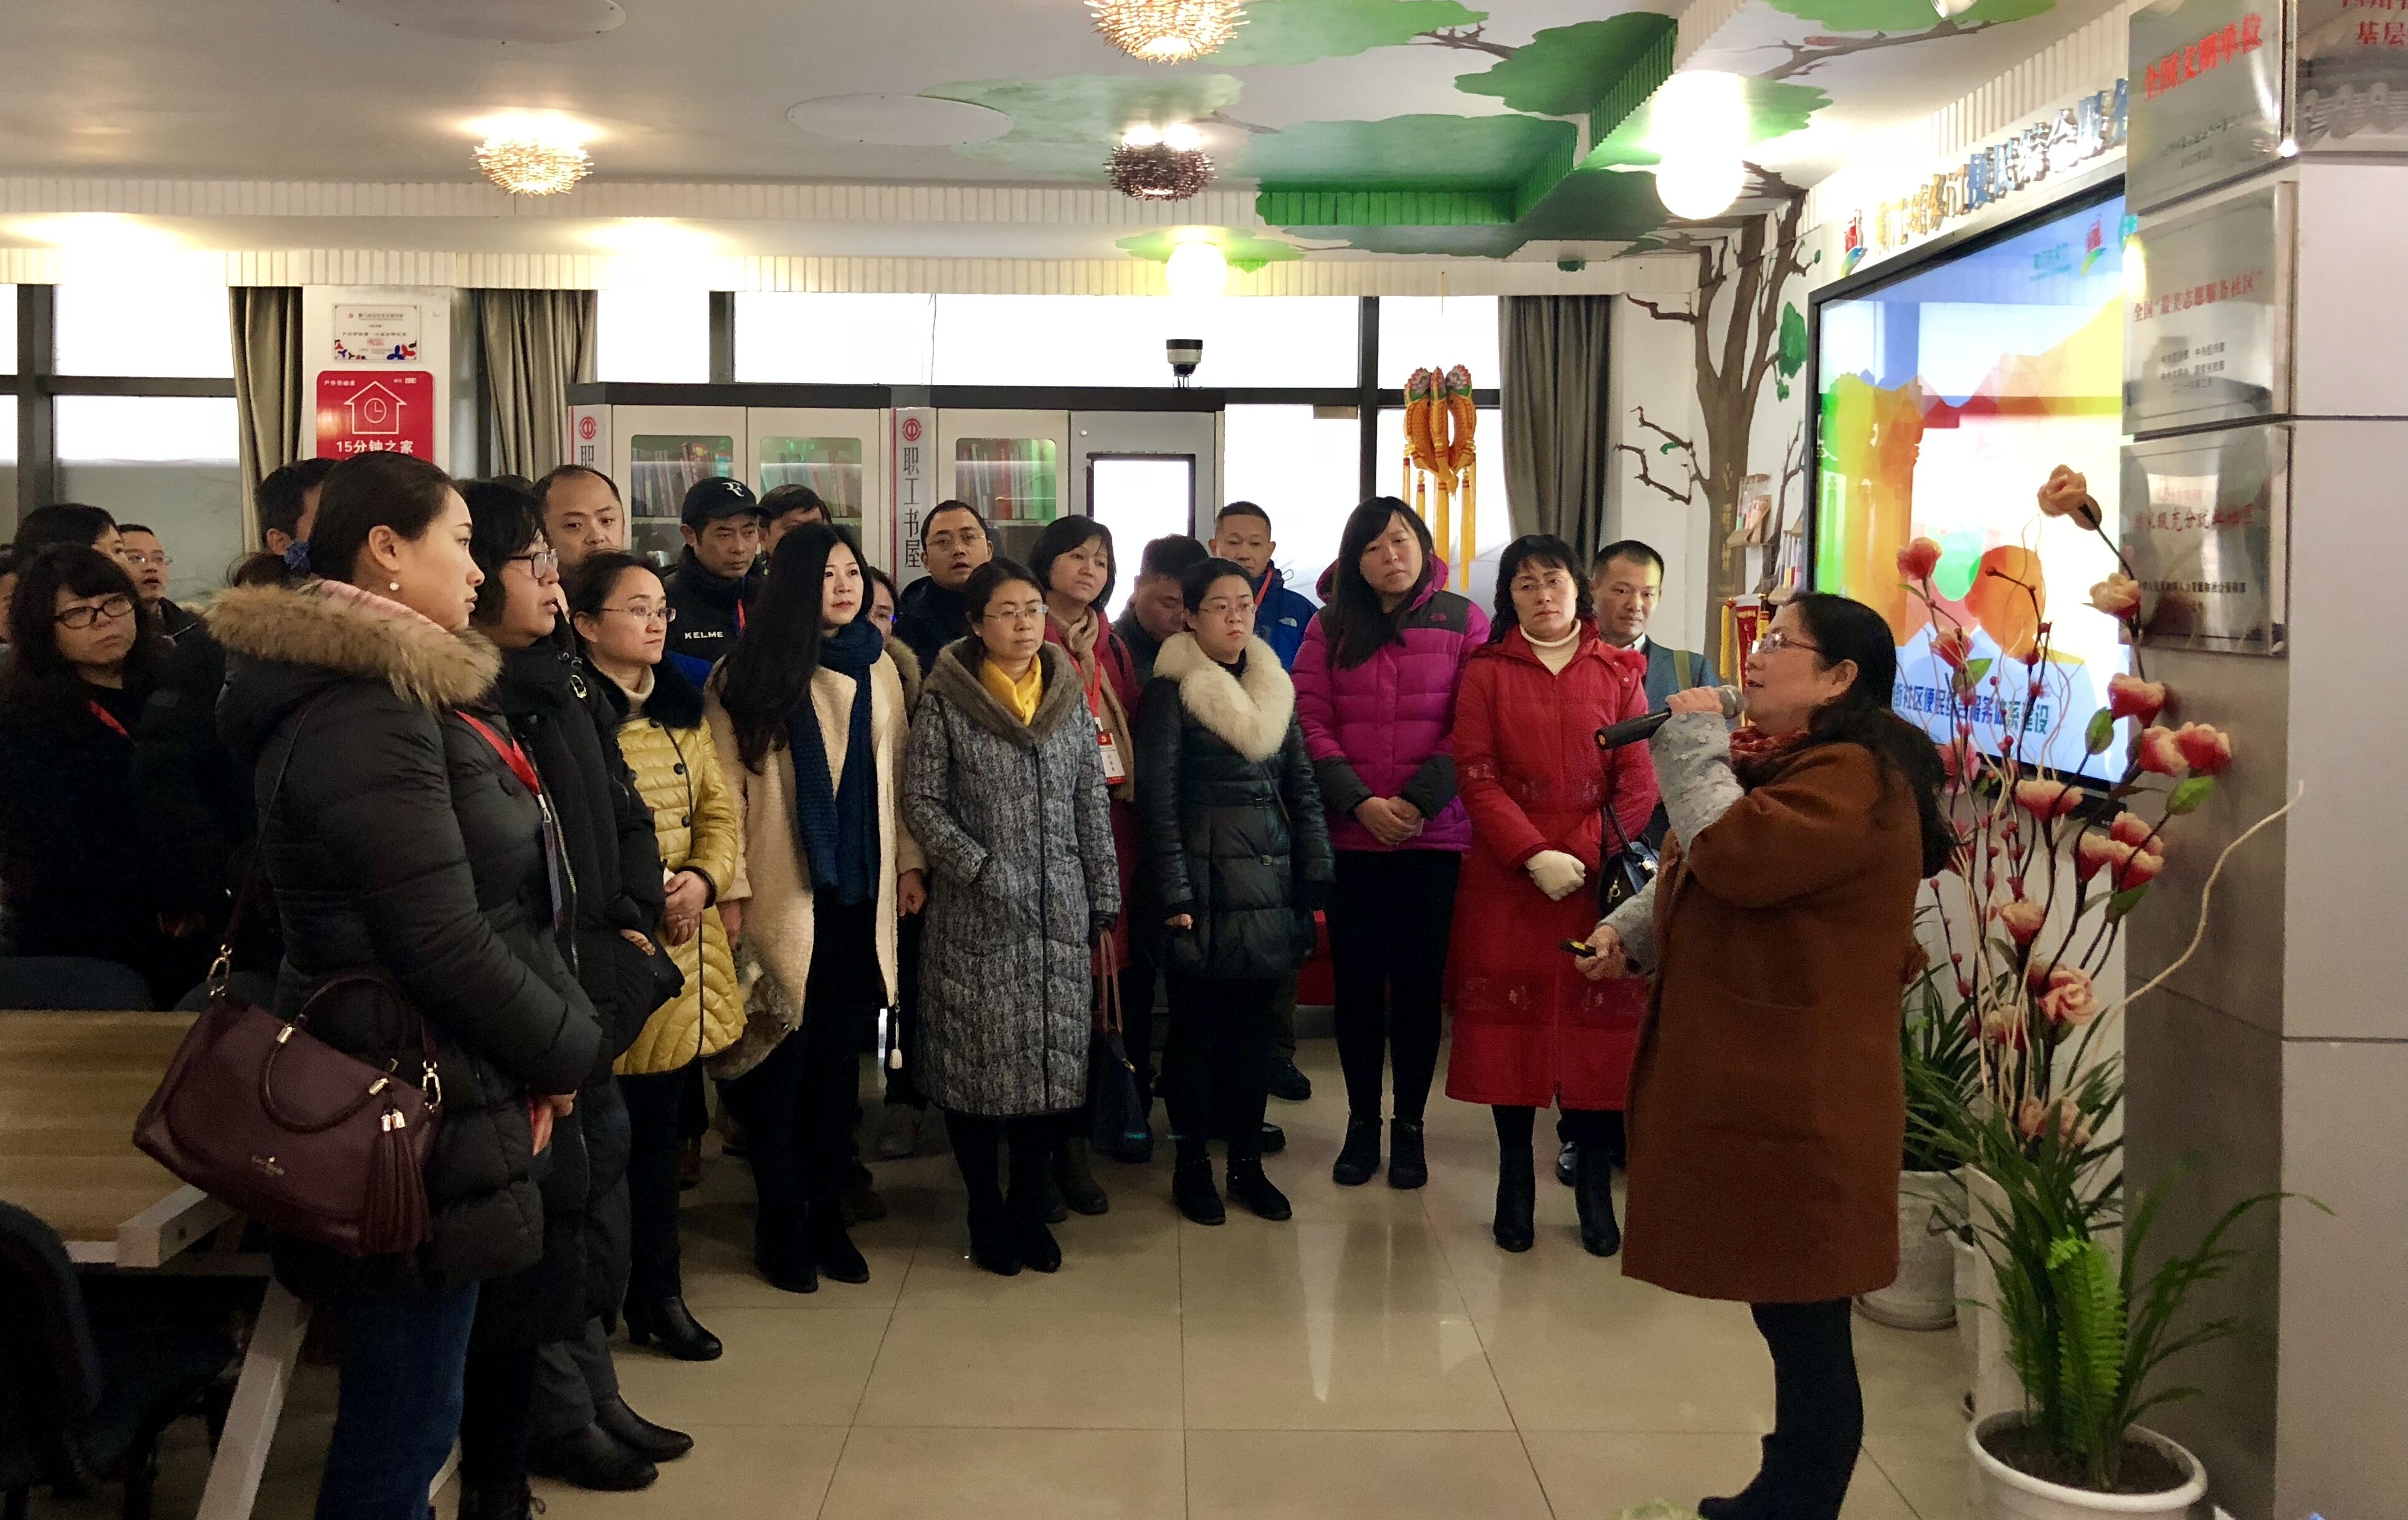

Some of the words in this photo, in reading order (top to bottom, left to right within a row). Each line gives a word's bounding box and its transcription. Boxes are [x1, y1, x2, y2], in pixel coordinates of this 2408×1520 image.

[336, 440, 414, 454] 15分钟之家
[903, 447, 921, 568] 职工书屋
[684, 631, 724, 639] KELME
